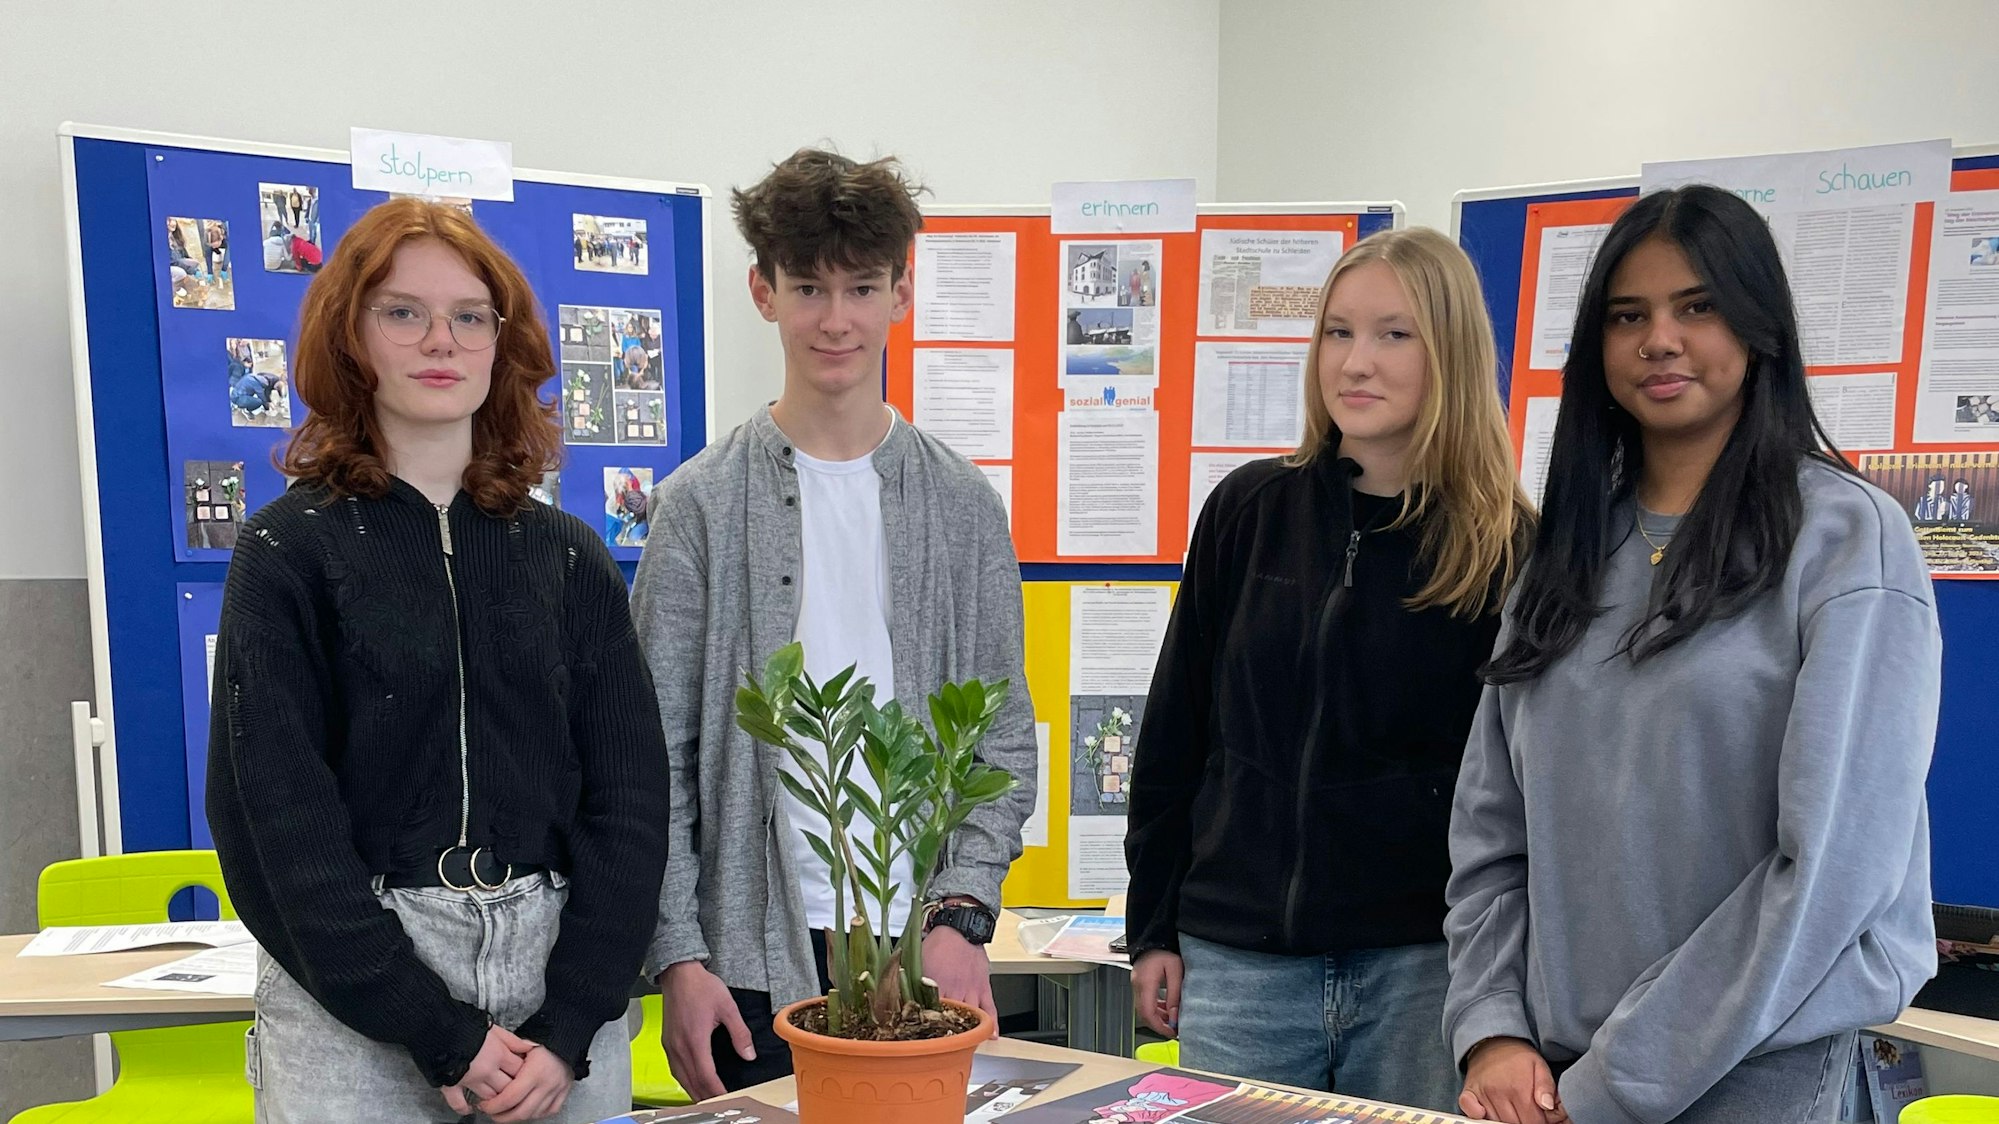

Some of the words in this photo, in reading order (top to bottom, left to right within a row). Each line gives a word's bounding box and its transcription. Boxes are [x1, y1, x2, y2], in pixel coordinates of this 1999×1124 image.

[379, 142, 473, 187] stolpern
[1815, 163, 1912, 195] Schauen
[1734, 187, 1777, 203] orne
[1081, 200, 1160, 217] erinnern
[1070, 396, 1103, 406] sozial
[1115, 396, 1151, 408] genial
